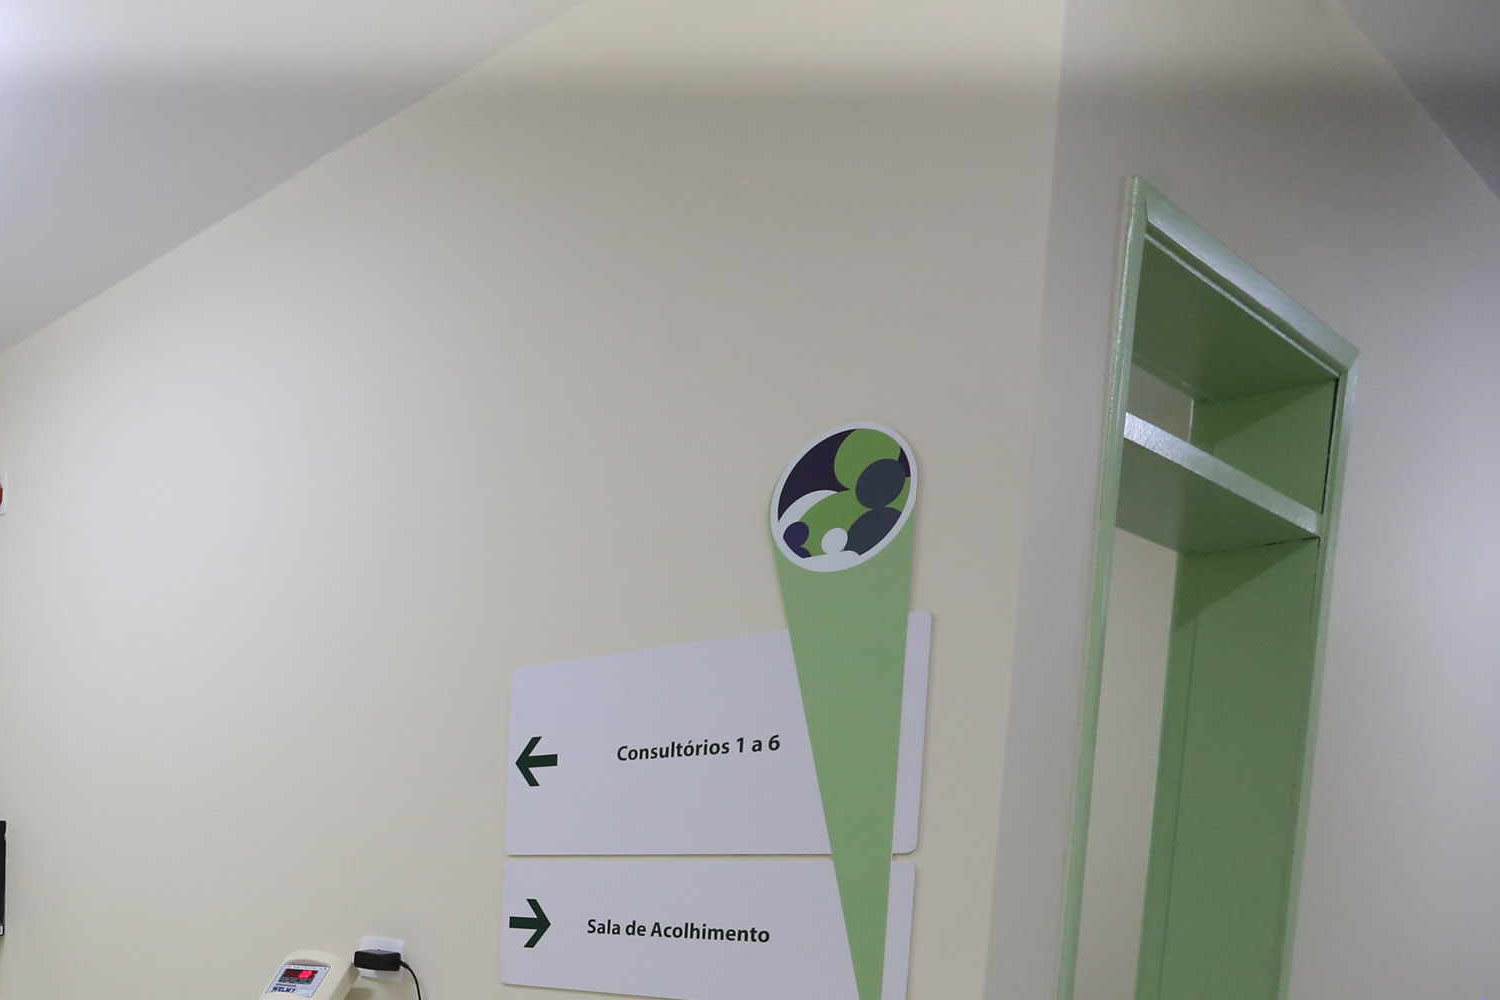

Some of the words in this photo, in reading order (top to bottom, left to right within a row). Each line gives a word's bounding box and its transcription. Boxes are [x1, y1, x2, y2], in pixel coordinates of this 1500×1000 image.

[617, 739, 730, 761] Consultórios
[736, 737, 745, 753] 1
[751, 739, 763, 752] a
[768, 734, 781, 751] 6
[587, 918, 621, 935] Sala
[625, 920, 647, 936] de
[650, 921, 771, 943] Acolhimento
